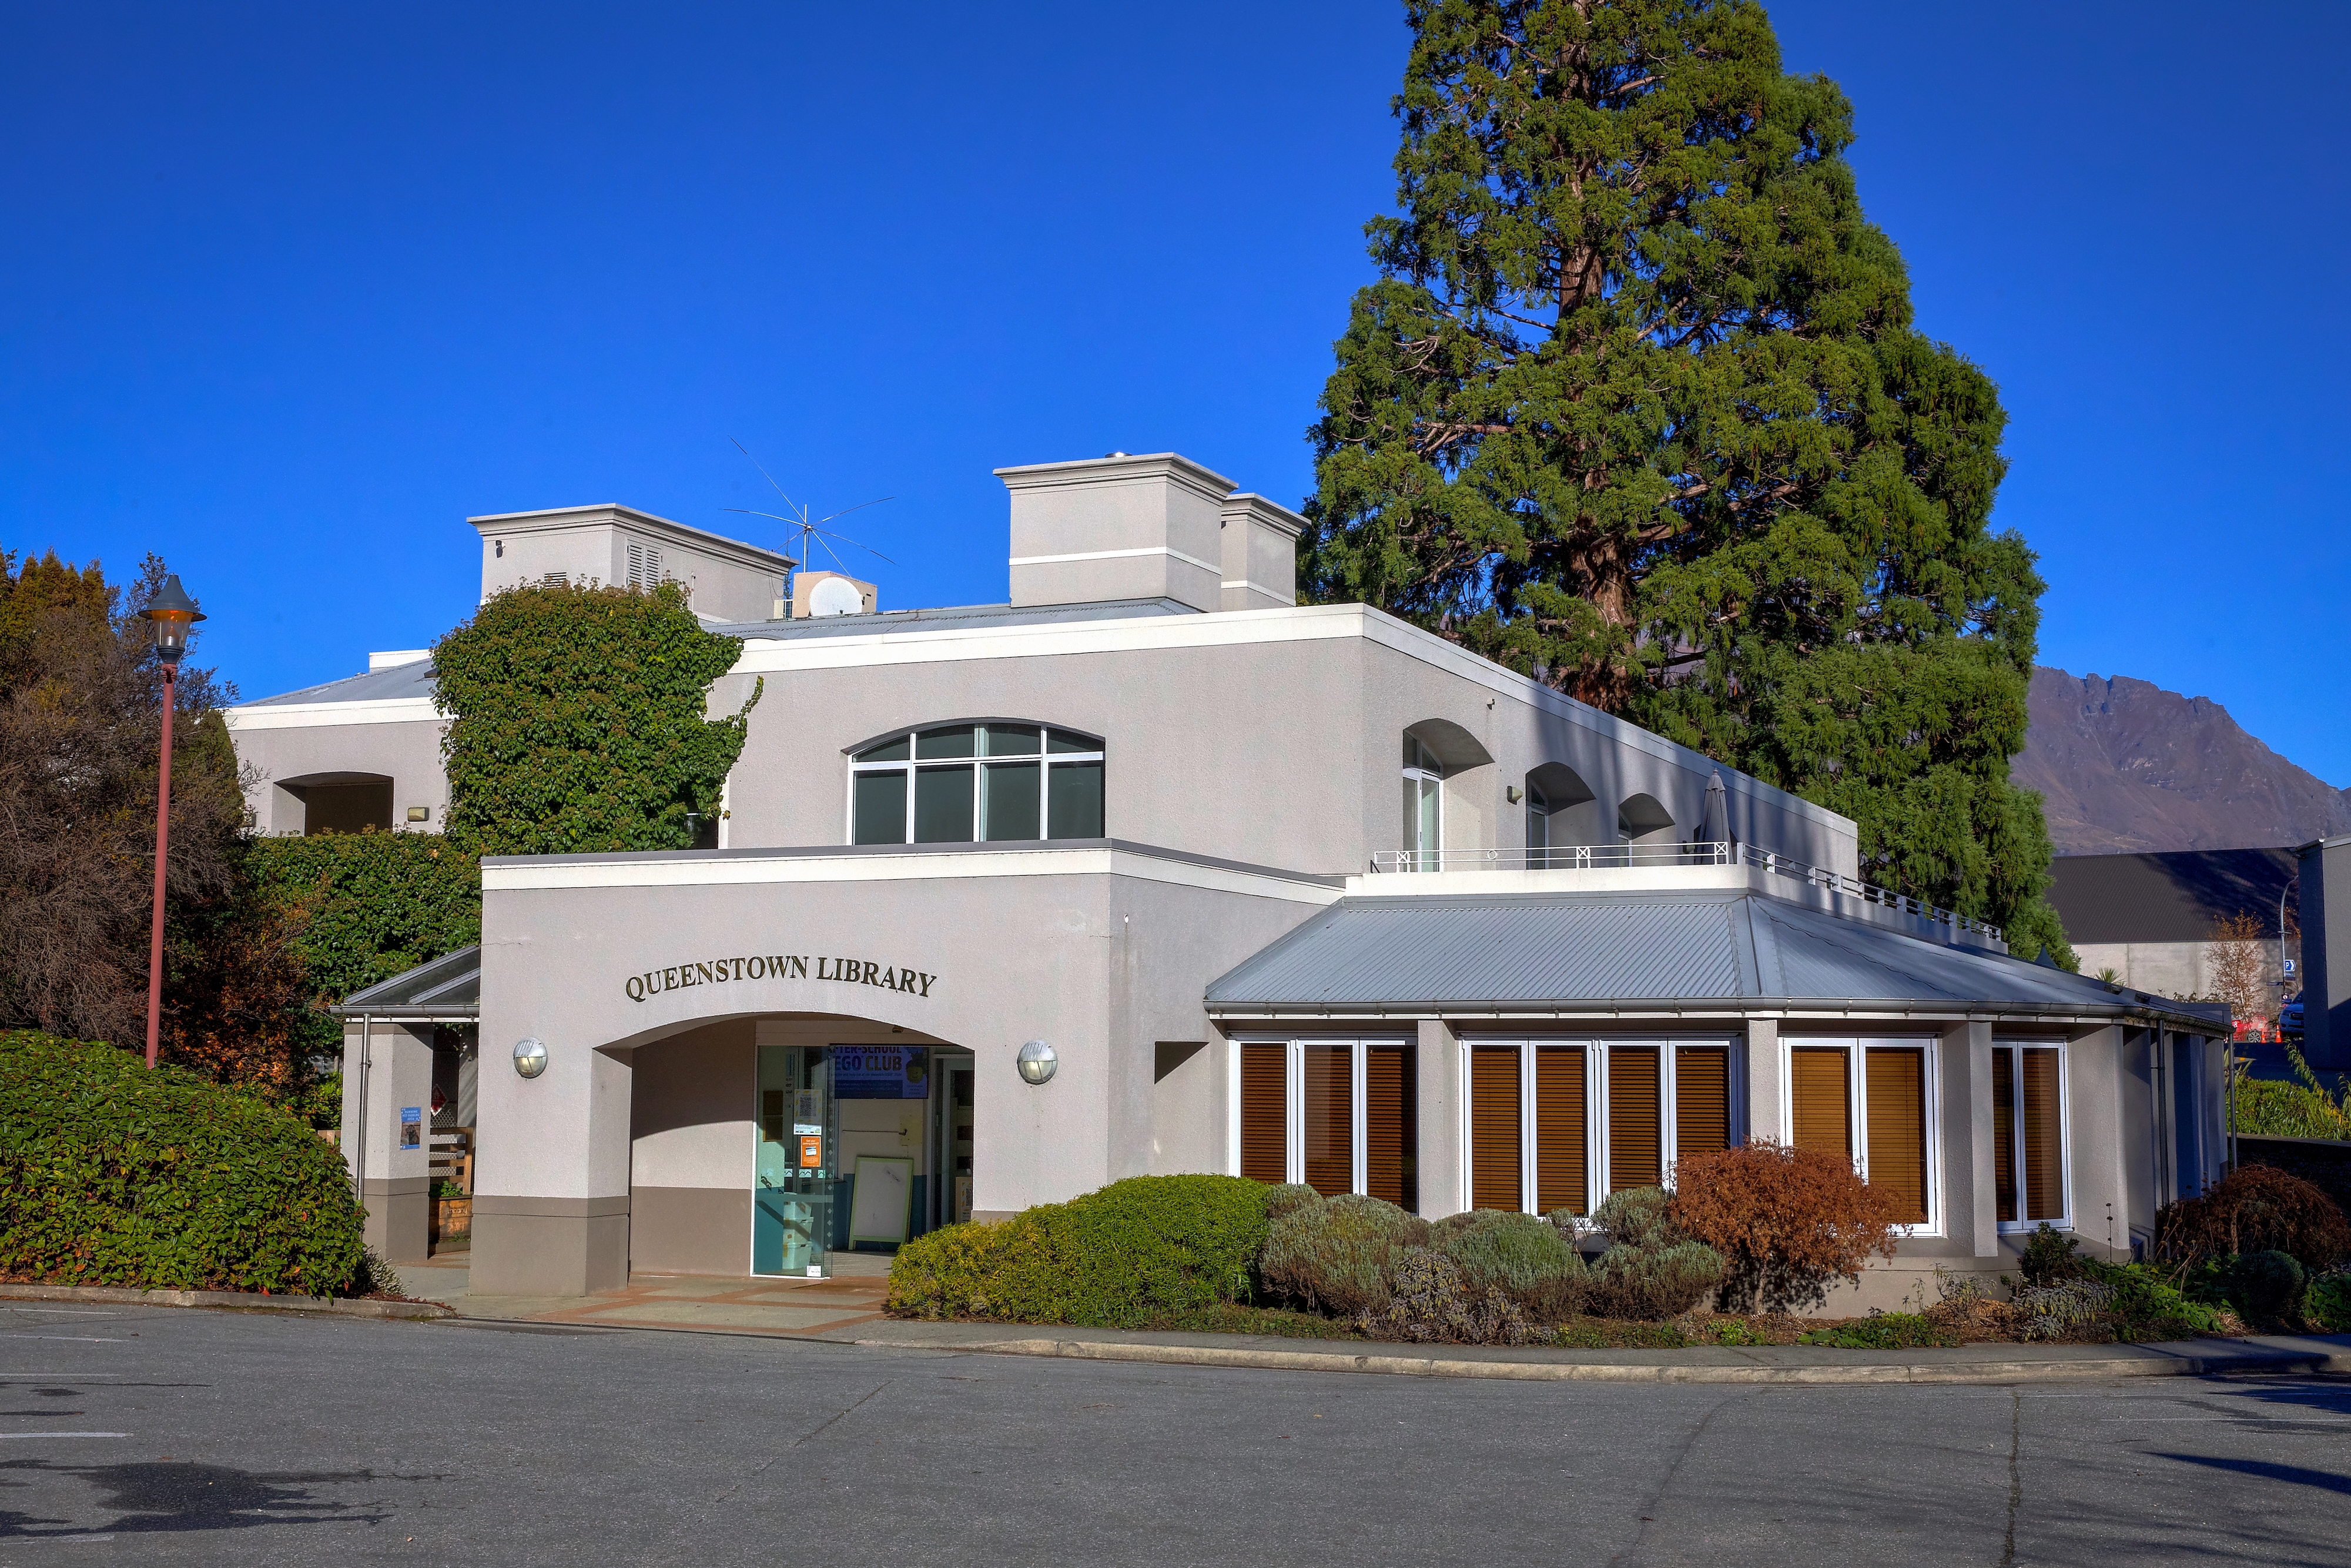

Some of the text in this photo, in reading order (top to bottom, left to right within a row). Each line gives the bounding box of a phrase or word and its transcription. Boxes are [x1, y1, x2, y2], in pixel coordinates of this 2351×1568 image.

[625, 956, 937, 1003] QUEENSTOWN LIBRARY
[835, 1056, 902, 1071] EGO CLUB
